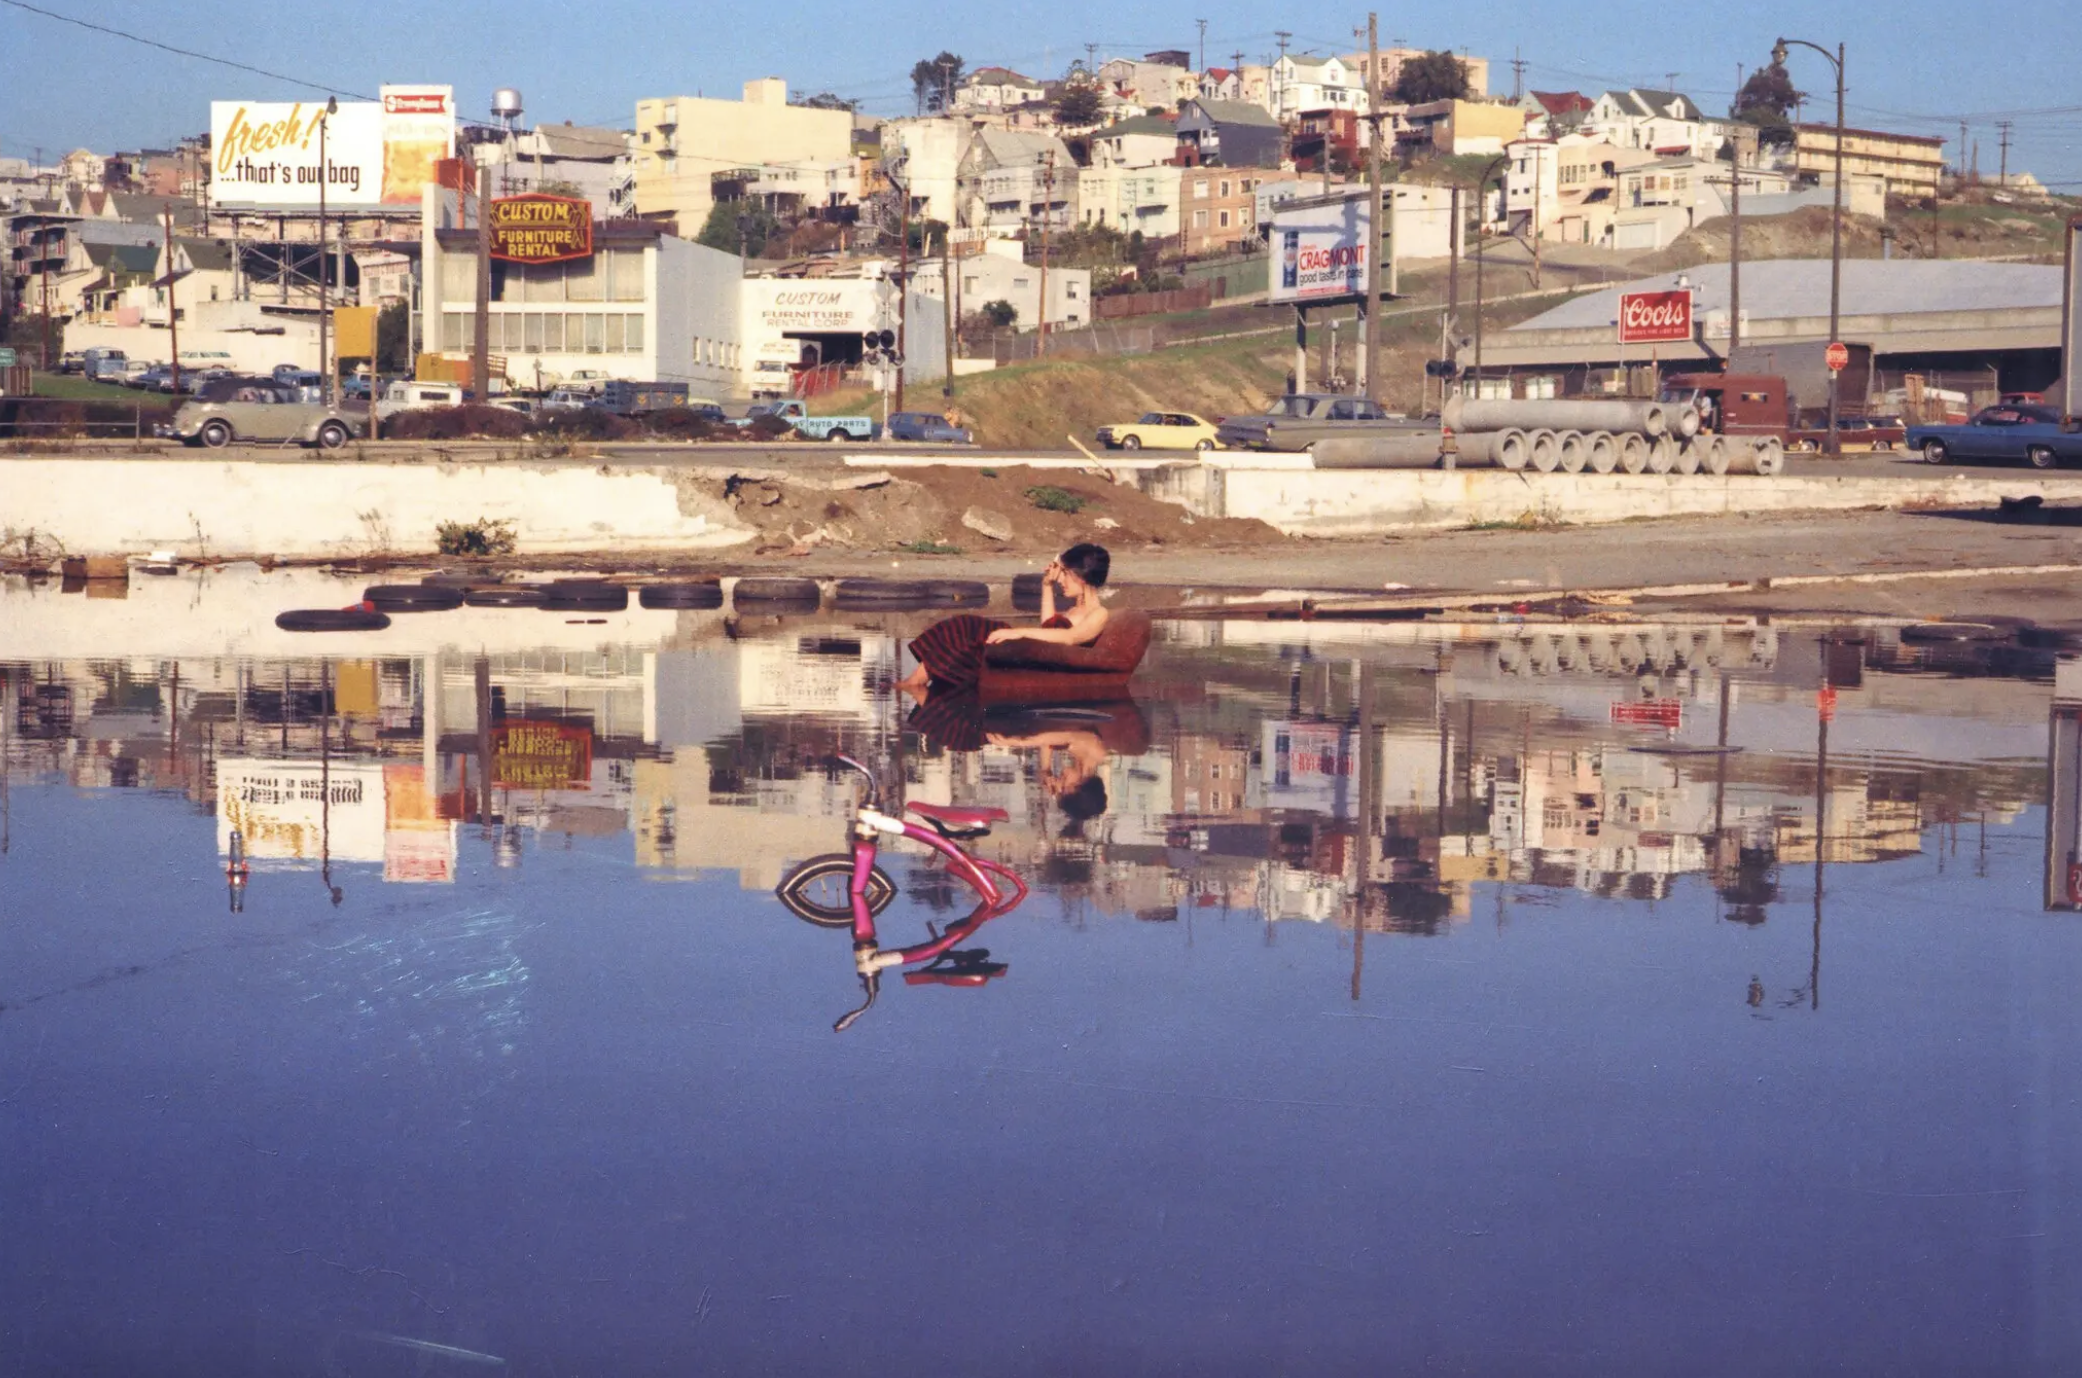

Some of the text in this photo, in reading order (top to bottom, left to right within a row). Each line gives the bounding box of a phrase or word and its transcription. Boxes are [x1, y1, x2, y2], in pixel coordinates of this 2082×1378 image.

[218, 103, 325, 173] fresh!
[328, 158, 360, 192] bag
[499, 203, 569, 221] CUSTOM
[498, 230, 572, 244] FURNITURE
[507, 243, 560, 256] RENTAL
[1300, 245, 1365, 270] CRAGMONT
[1300, 272, 1317, 287] good
[775, 292, 842, 305] CUSTOM
[762, 311, 854, 319] FURNITURE
[1624, 298, 1685, 327] Coors
[767, 318, 810, 327] RENTAL
[1827, 350, 1848, 362] STOP
